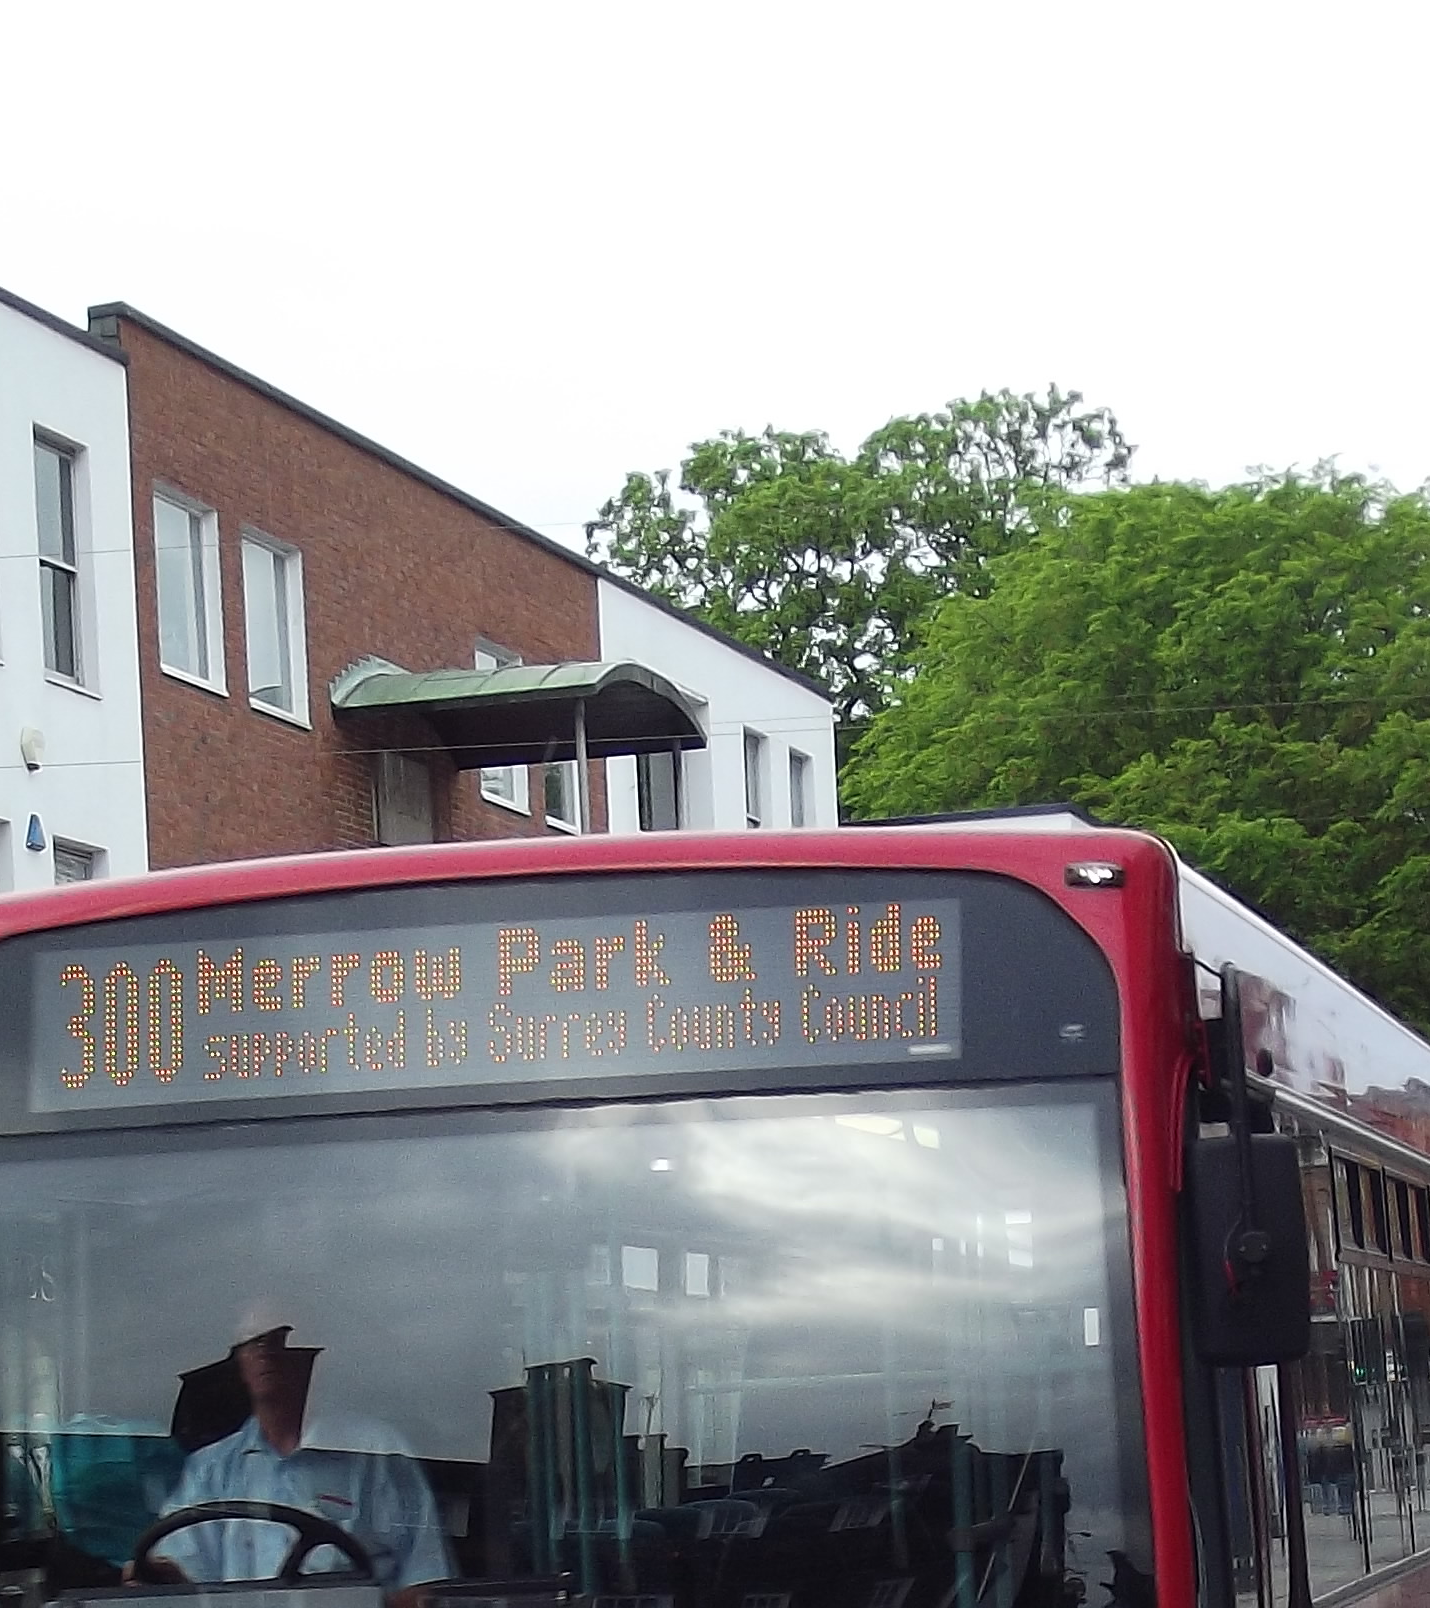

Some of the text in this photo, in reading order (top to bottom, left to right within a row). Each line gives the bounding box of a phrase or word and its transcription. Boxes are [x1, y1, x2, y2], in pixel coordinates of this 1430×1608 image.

[196, 903, 942, 1015] Merrow Park & Ride
[61, 958, 185, 1088] 300
[202, 976, 939, 1080] supported by Surrey County Council
